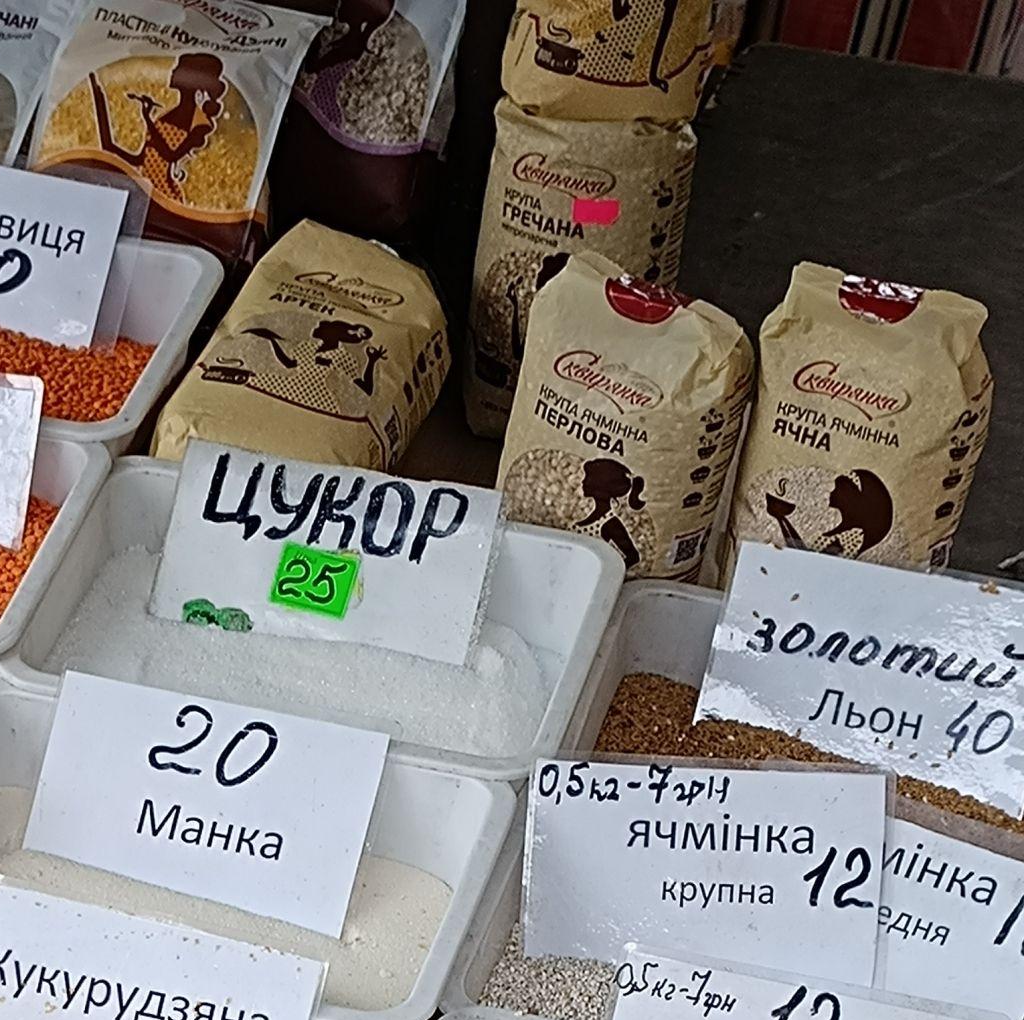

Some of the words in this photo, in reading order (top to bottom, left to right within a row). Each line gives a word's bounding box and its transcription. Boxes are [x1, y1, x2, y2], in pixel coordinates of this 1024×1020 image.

[502, 202, 584, 240] ГРЕЧАНА
[504, 187, 542, 211] КРУПА
[269, 292, 336, 317] АРТЕК
[792, 360, 903, 415] Сквирянка
[534, 398, 625, 458] ПЕРЛОВА
[539, 384, 578, 417] КРУПА
[580, 408, 649, 444] ЯЧМІННА
[772, 418, 831, 453] ЯЧНА
[776, 401, 826, 428] КРУПА
[829, 416, 900, 448] ЯЧМІННА
[201, 452, 470, 565] ЦУКОР
[277, 557, 350, 605] 25
[147, 704, 279, 788] 20
[808, 687, 924, 741] Льон
[945, 700, 1015, 756] 40
[136, 798, 285, 862] Манка
[626, 812, 815, 855] ячмінка
[802, 845, 876, 909] 12
[660, 878, 775, 909] крупна
[877, 904, 951, 947] едня
